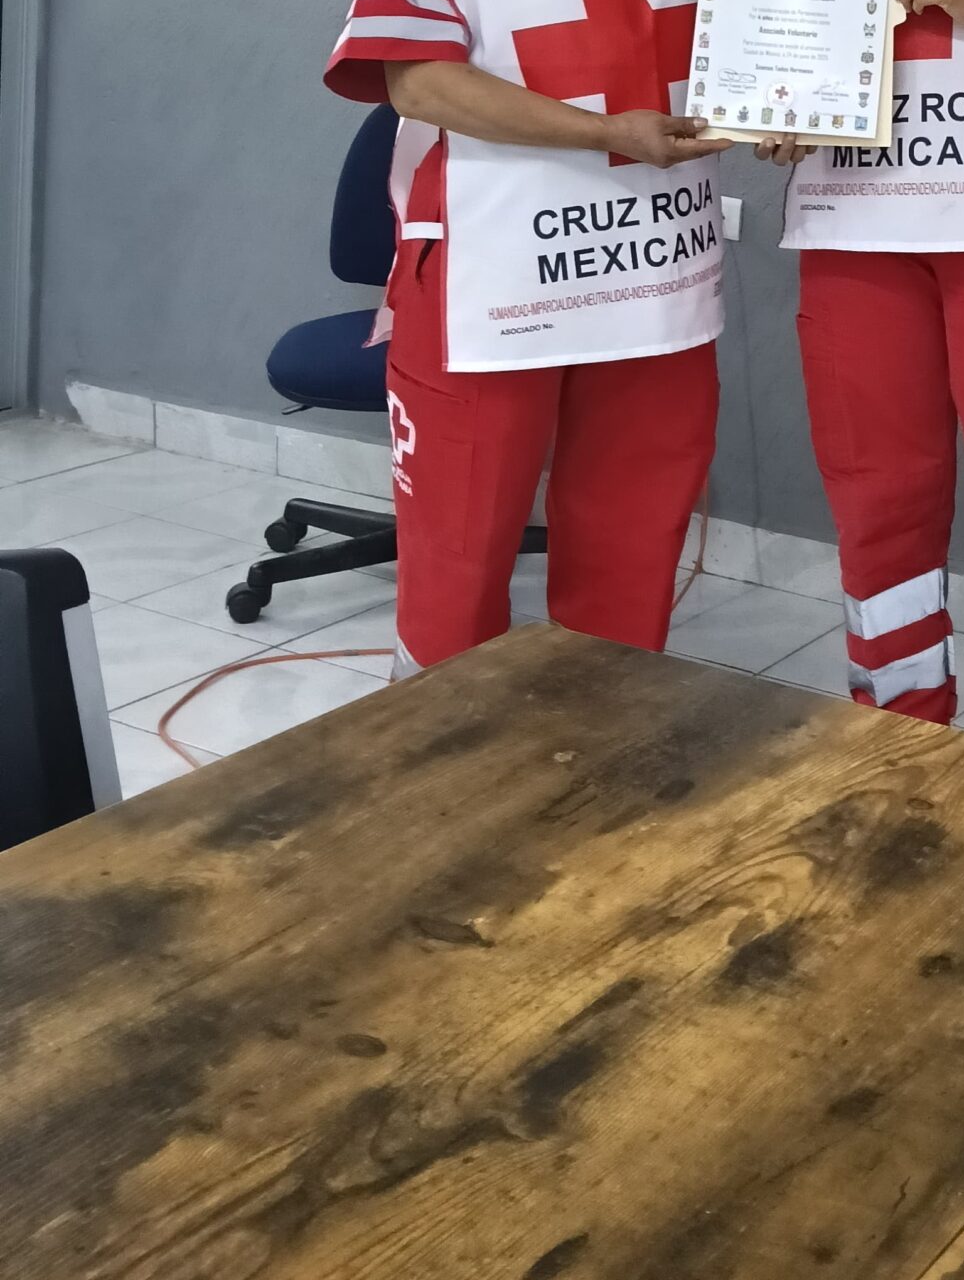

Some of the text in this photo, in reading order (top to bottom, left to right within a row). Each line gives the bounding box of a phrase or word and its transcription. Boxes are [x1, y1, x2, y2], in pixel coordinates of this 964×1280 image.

[533, 178, 713, 240] CRUZ ROJA
[537, 220, 717, 285] MEXICANA
[500, 323, 541, 336] ASOCIADO
